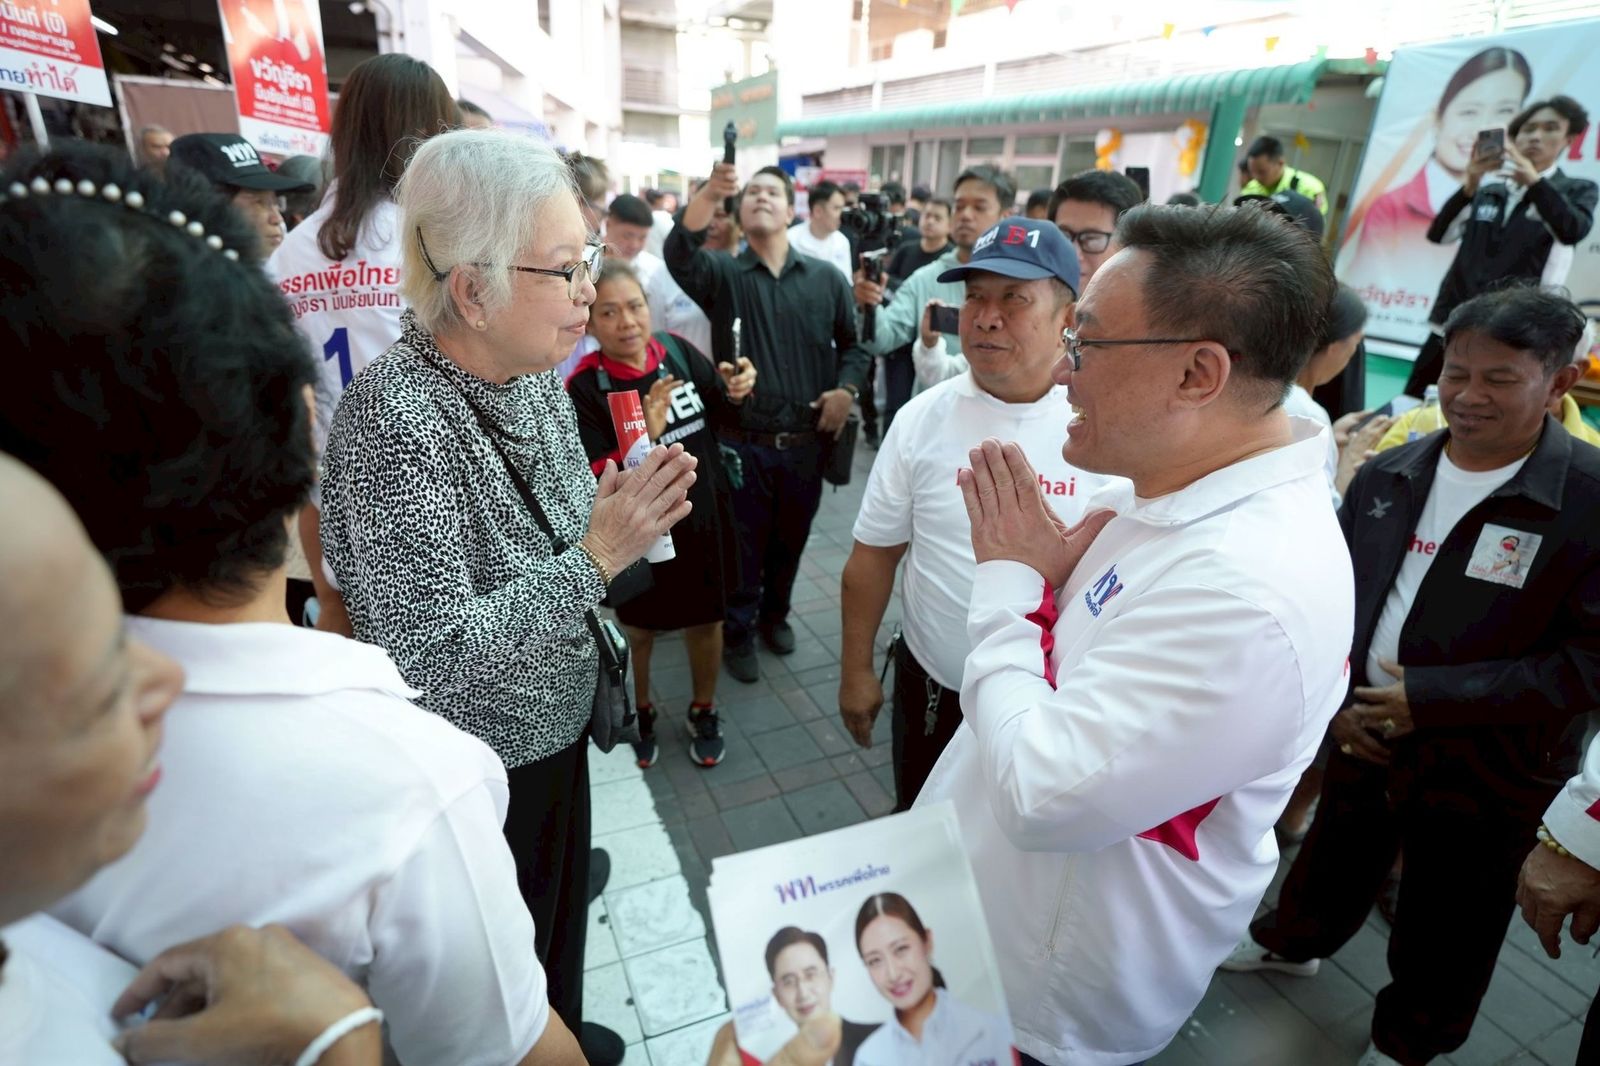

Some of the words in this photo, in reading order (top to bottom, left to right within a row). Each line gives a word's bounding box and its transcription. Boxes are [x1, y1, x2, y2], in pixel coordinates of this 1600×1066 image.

[279, 258, 401, 295] รรคเพื่อไทย
[322, 327, 354, 390] 1
[1037, 474, 1077, 497] hai
